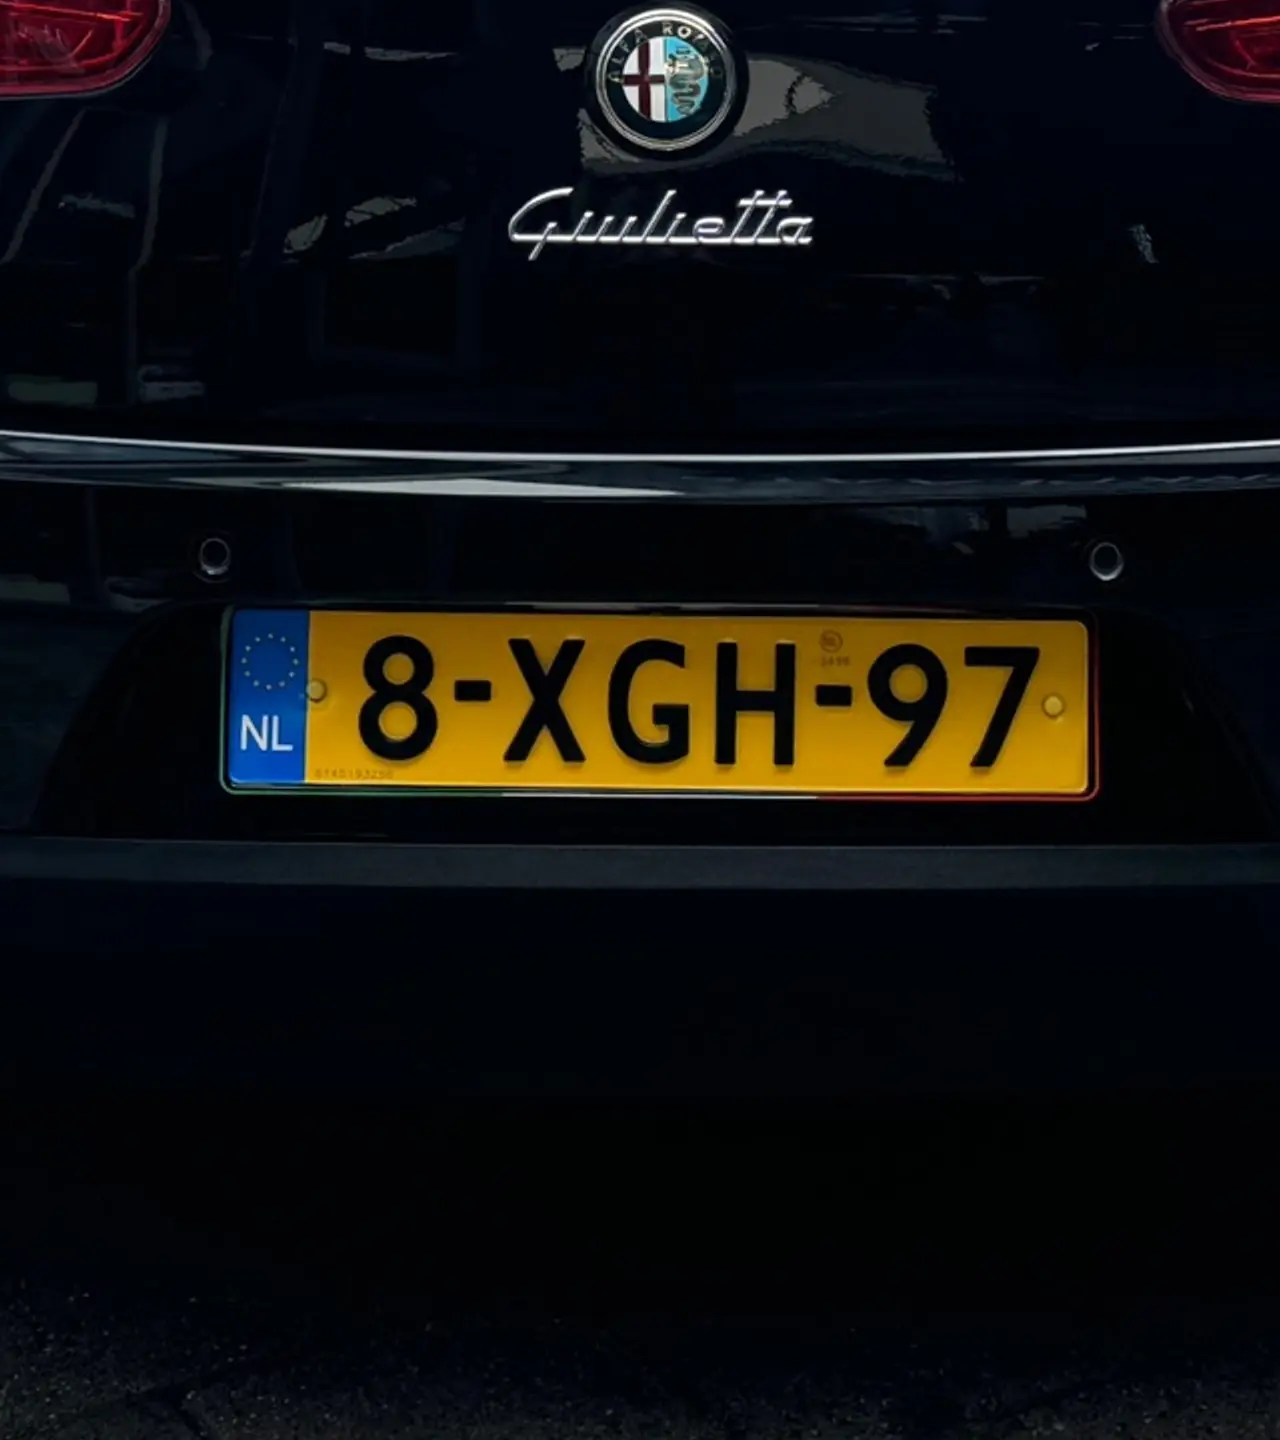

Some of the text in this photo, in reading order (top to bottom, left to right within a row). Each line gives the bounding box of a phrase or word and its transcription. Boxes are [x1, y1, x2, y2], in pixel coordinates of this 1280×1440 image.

[507, 187, 814, 261] Giulietta
[239, 713, 295, 752] NL
[356, 635, 1041, 770] 8-XGH-97
